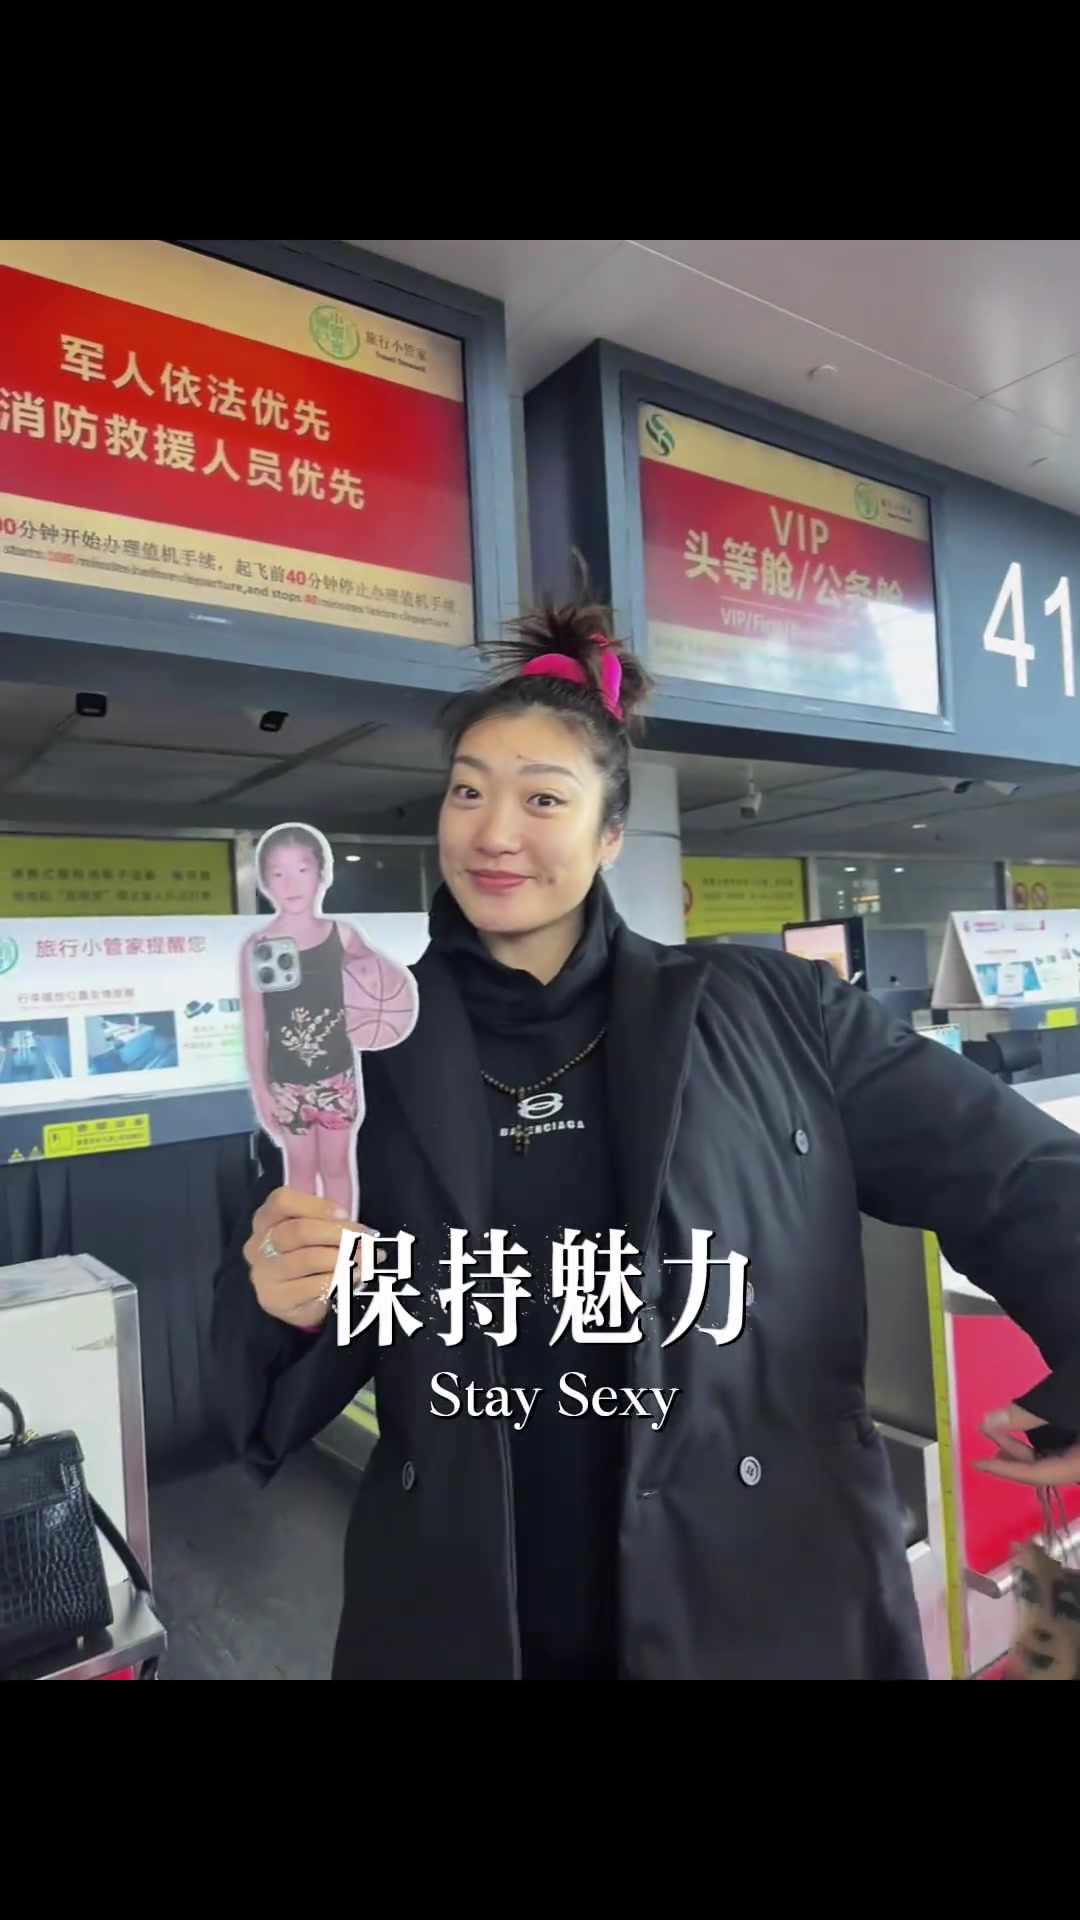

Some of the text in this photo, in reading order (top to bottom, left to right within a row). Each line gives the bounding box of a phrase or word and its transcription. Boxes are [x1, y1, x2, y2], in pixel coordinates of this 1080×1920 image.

[60, 333, 331, 442] 军人依法优先
[0, 387, 365, 511] 消防救援人员优先
[769, 504, 829, 555] VIP
[983, 561, 1075, 697] 41
[35, 936, 207, 959] 旅行小管家提醒您
[500, 1119, 585, 1137] BAENCIAGA
